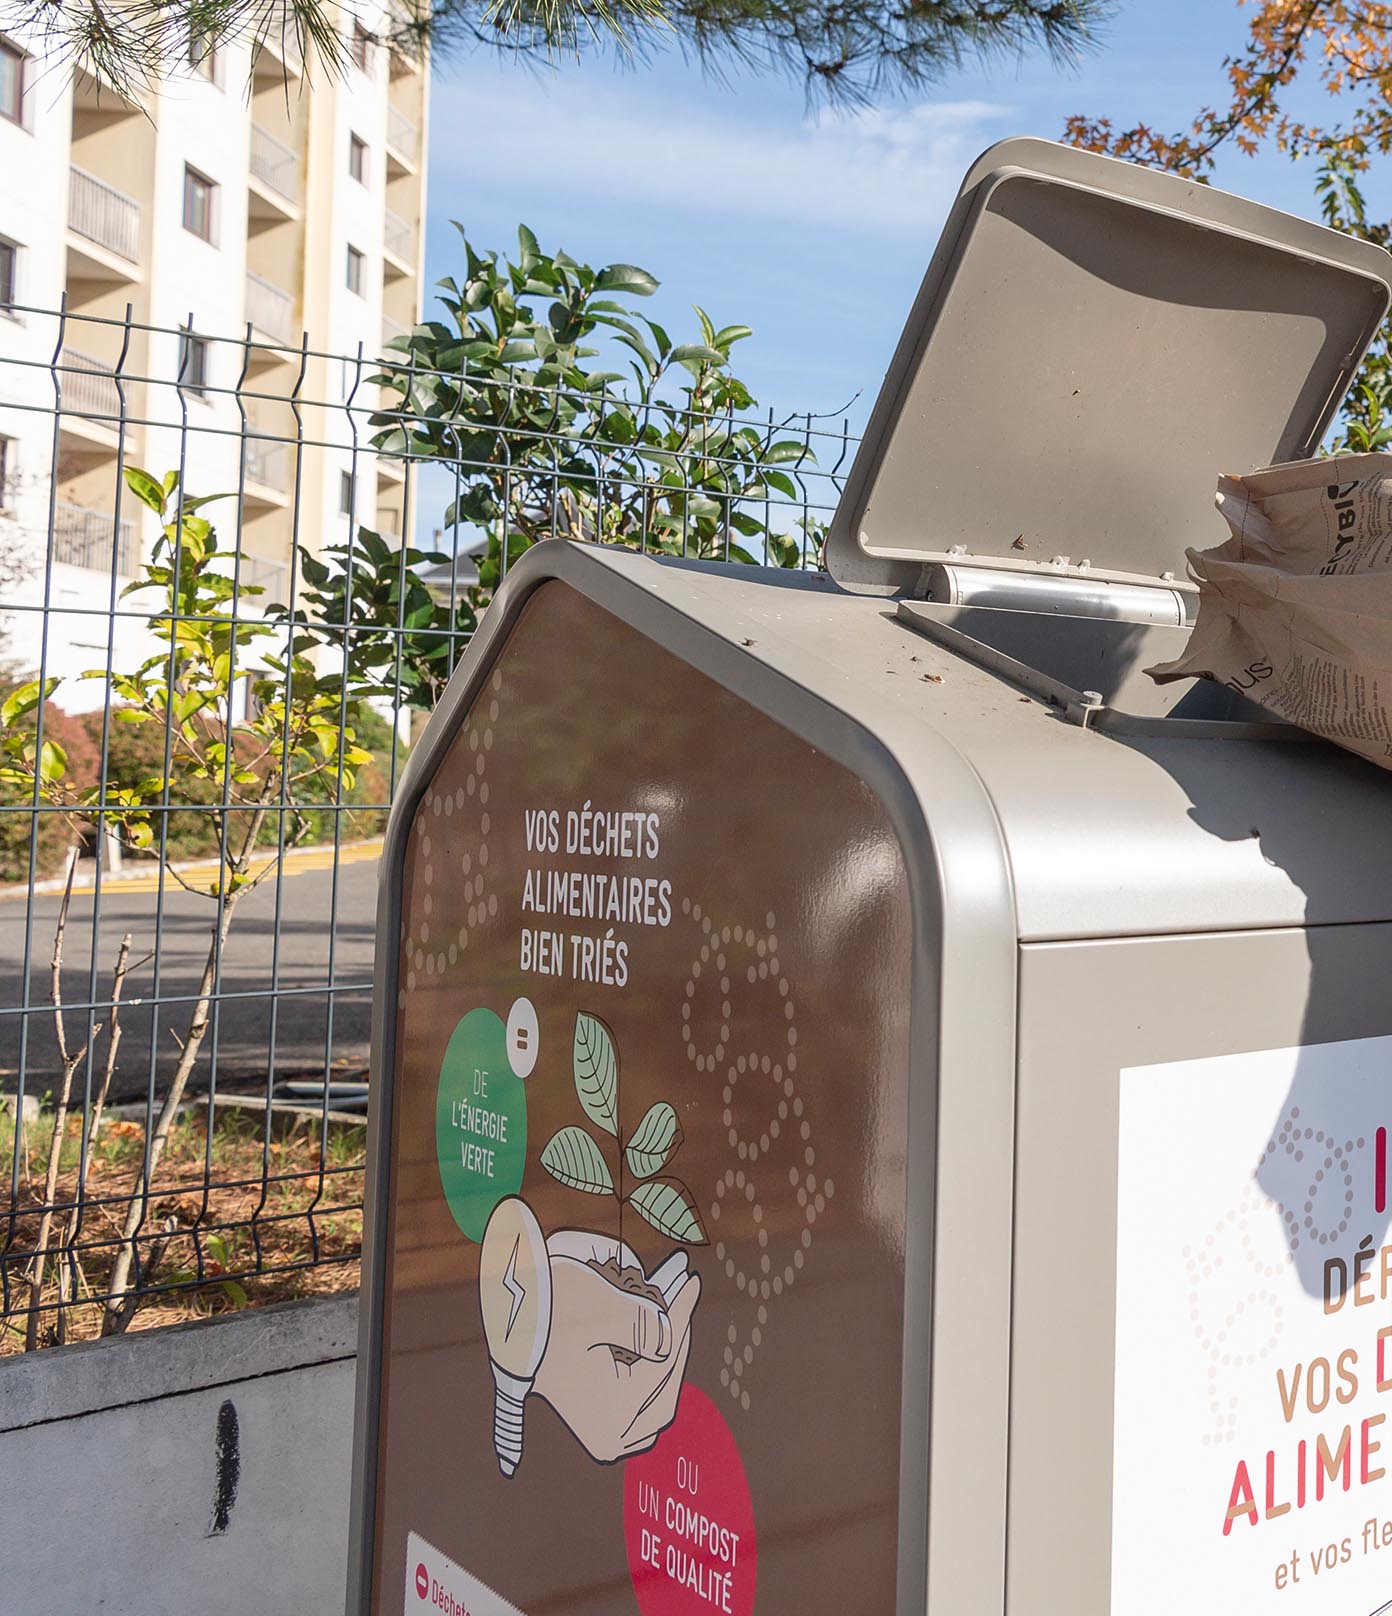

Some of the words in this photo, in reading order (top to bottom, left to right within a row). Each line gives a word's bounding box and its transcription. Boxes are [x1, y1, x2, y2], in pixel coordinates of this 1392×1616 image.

[524, 809, 560, 853] VOS
[566, 799, 661, 860] DÉCHETS
[521, 869, 673, 928] ALIMENTAIRES
[519, 928, 564, 976] BIEN
[570, 927, 630, 988] TRIÉS
[472, 1068, 489, 1097] DE
[451, 1099, 509, 1145] L'ÉNERGIE
[460, 1140, 496, 1178] VERTE
[1275, 1347, 1360, 1424] VOS
[676, 1455, 700, 1496] OU
[637, 1479, 661, 1522] UN
[665, 1496, 741, 1568] COMPOST
[640, 1527, 662, 1570] DE
[665, 1551, 734, 1614] QUALITÉ
[1273, 1550, 1301, 1590] et
[1310, 1535, 1353, 1576] vos
